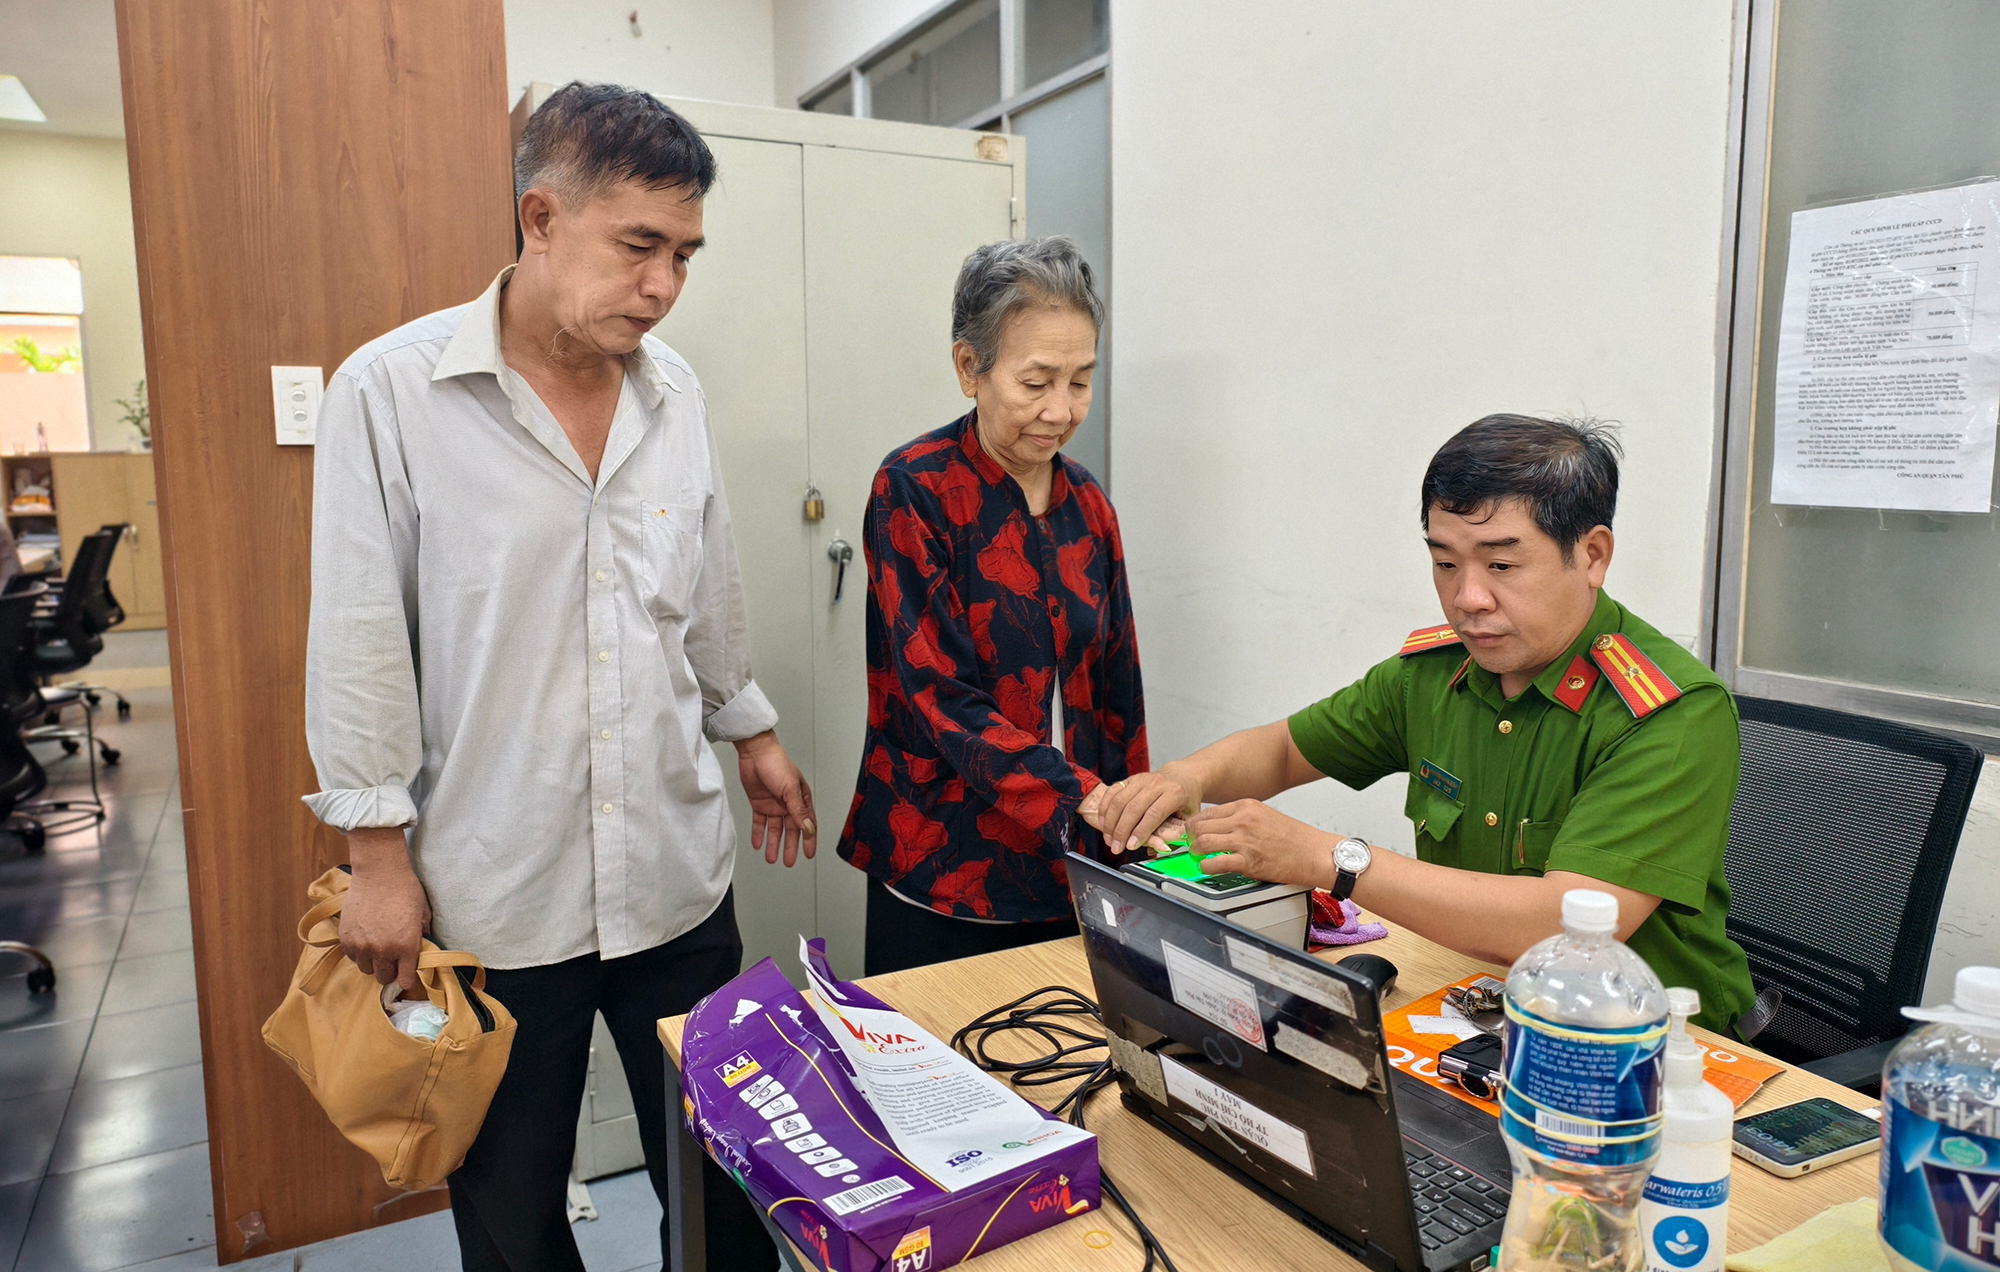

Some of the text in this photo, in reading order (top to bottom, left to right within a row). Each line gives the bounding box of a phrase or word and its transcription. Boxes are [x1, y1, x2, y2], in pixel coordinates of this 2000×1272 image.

[842, 1015, 918, 1044] VIVA
[878, 1042, 929, 1056] Extra
[723, 1054, 749, 1076] A4
[1193, 1087, 1218, 1108] MINH
[1256, 1122, 1267, 1136] TP
[945, 1149, 983, 1168] ISO
[1645, 1180, 1704, 1198] arwateris
[1029, 1185, 1072, 1216] VIVA
[896, 1248, 927, 1272] A4
